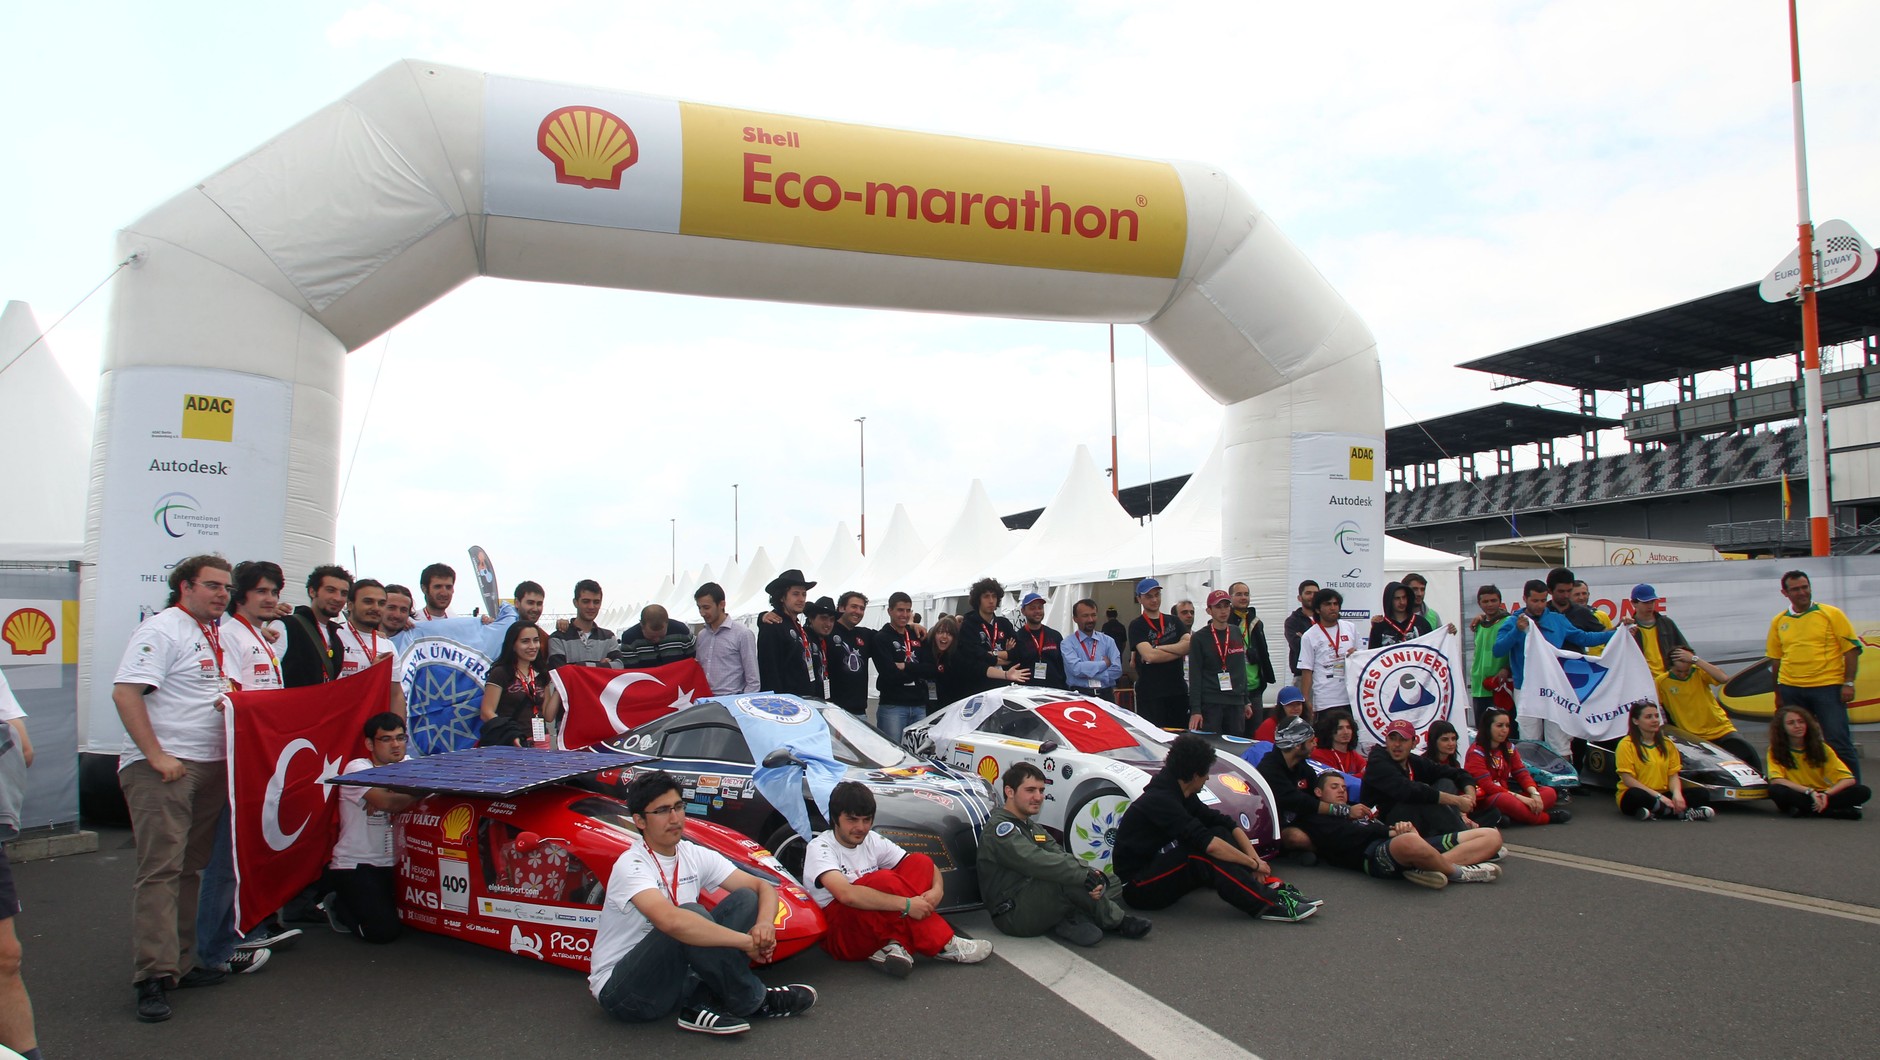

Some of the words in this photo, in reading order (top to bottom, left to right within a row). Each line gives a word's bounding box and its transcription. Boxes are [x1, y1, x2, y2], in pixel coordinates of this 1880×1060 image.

[742, 126, 800, 149] Shell
[185, 396, 233, 414] ADAC
[1351, 447, 1374, 460] ADAC
[149, 458, 229, 476] Autodesk
[1328, 495, 1373, 507] Autodesk
[173, 513, 221, 523] International
[186, 521, 220, 529] Transport
[1648, 551, 1679, 562] Autocars
[140, 574, 158, 582] THE
[1732, 768, 1758, 777] 112
[411, 865, 436, 878] HEXAGON
[442, 875, 468, 894] 409
[488, 883, 540, 896] elektrikport.com
[405, 886, 439, 910] AKS
[579, 915, 597, 923] SKF
[475, 925, 500, 935] Mahindra
[550, 931, 593, 953] PRO
